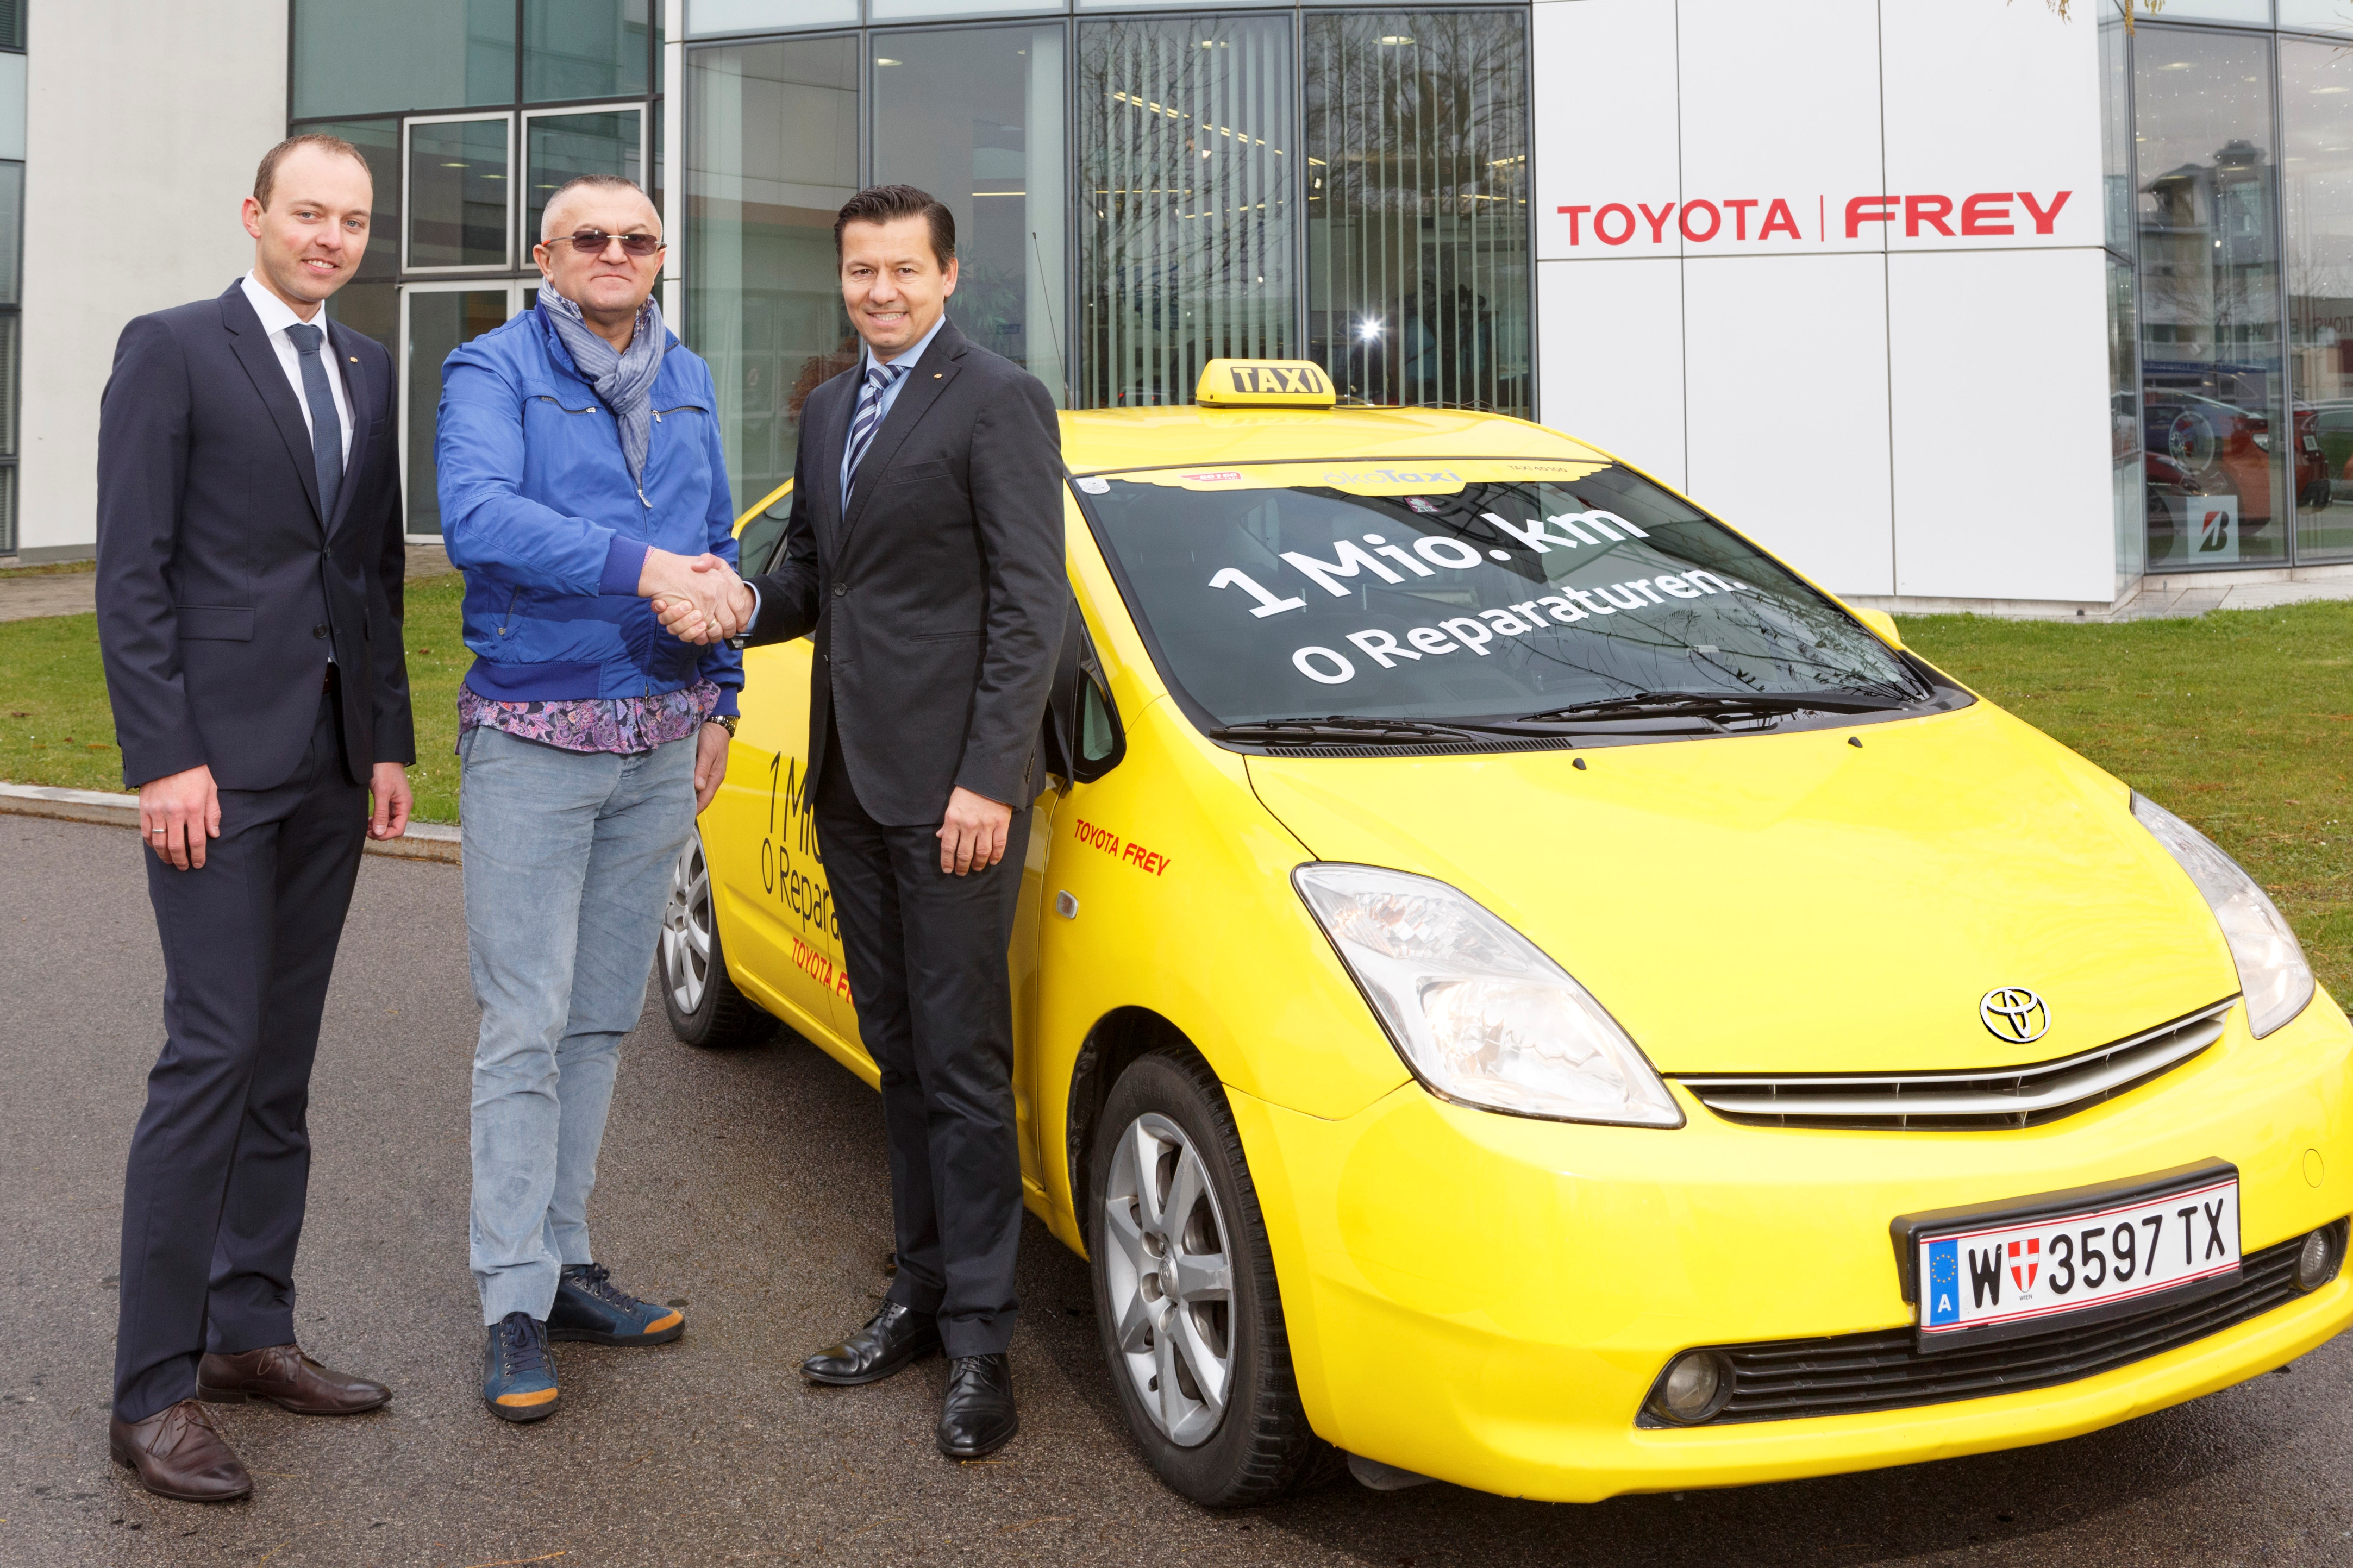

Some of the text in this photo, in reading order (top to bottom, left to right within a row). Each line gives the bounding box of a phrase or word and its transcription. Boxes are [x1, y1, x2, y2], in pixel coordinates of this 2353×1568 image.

[1557, 191, 2073, 246] TOYOTA FREY
[1232, 368, 1319, 392] TAXI
[1208, 567, 1307, 618] 1
[1346, 570, 1747, 668] Reparaturen.
[769, 751, 781, 834] 1
[1074, 819, 1171, 876] TOYOTA FREY
[792, 936, 832, 991] TOYOTA
[1968, 1198, 2225, 1308] W 3597 TX
[1937, 1294, 1952, 1313] A
